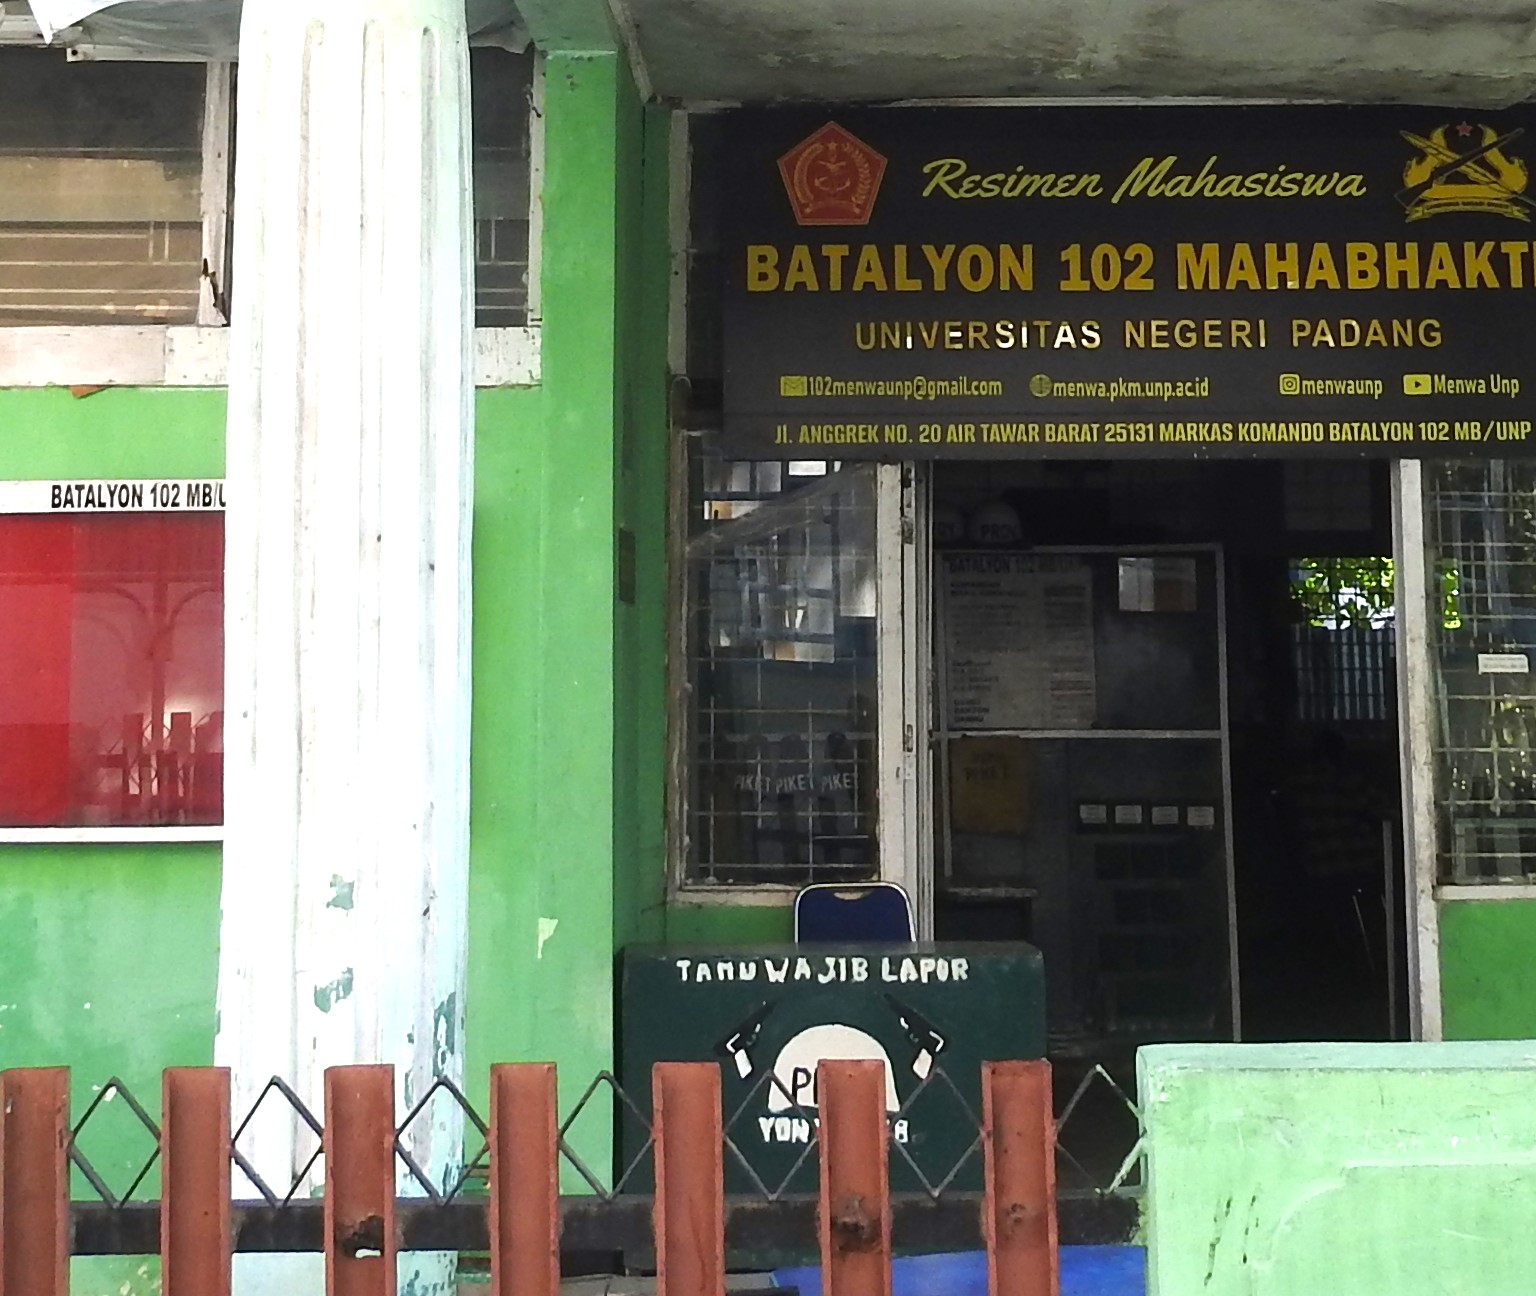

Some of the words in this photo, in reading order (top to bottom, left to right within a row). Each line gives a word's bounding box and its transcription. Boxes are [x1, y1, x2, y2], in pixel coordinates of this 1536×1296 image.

[922, 157, 1103, 199] Resimen
[1111, 155, 1366, 204] Mahasiswa
[746, 243, 1034, 292] BATALYON
[1059, 243, 1155, 292] 102
[855, 320, 1102, 351] UNIVERSITAS
[1125, 319, 1266, 349] NEGERI
[1291, 318, 1443, 348] PADANG
[808, 375, 1003, 401] 102menwaunp@gmail.com
[1053, 377, 1209, 402] menwa.pkm.unp.ac.id
[1302, 376, 1383, 400] menwaunp
[1434, 374, 1485, 394] Menwa
[1491, 374, 1520, 399] Unp
[798, 424, 879, 445] ANGGREK
[884, 423, 913, 444] NO.
[918, 423, 941, 444] 20
[946, 423, 975, 443] AIR
[980, 423, 1040, 443] TAWAR
[1044, 423, 1099, 443] BARAT
[1104, 422, 1154, 443] 25131
[1159, 422, 1233, 443] MARKAS
[1238, 422, 1324, 442] KOMANDO
[1329, 422, 1414, 442] BATALYON
[1418, 422, 1449, 442] 102
[1454, 421, 1532, 442] MB/UNP
[51, 483, 143, 508] BATALYON
[150, 483, 180, 508] 102
[677, 959, 756, 982] TAMU
[764, 957, 869, 983] WAJIB
[881, 957, 970, 983] LAPOR
[758, 1116, 810, 1143] YON
